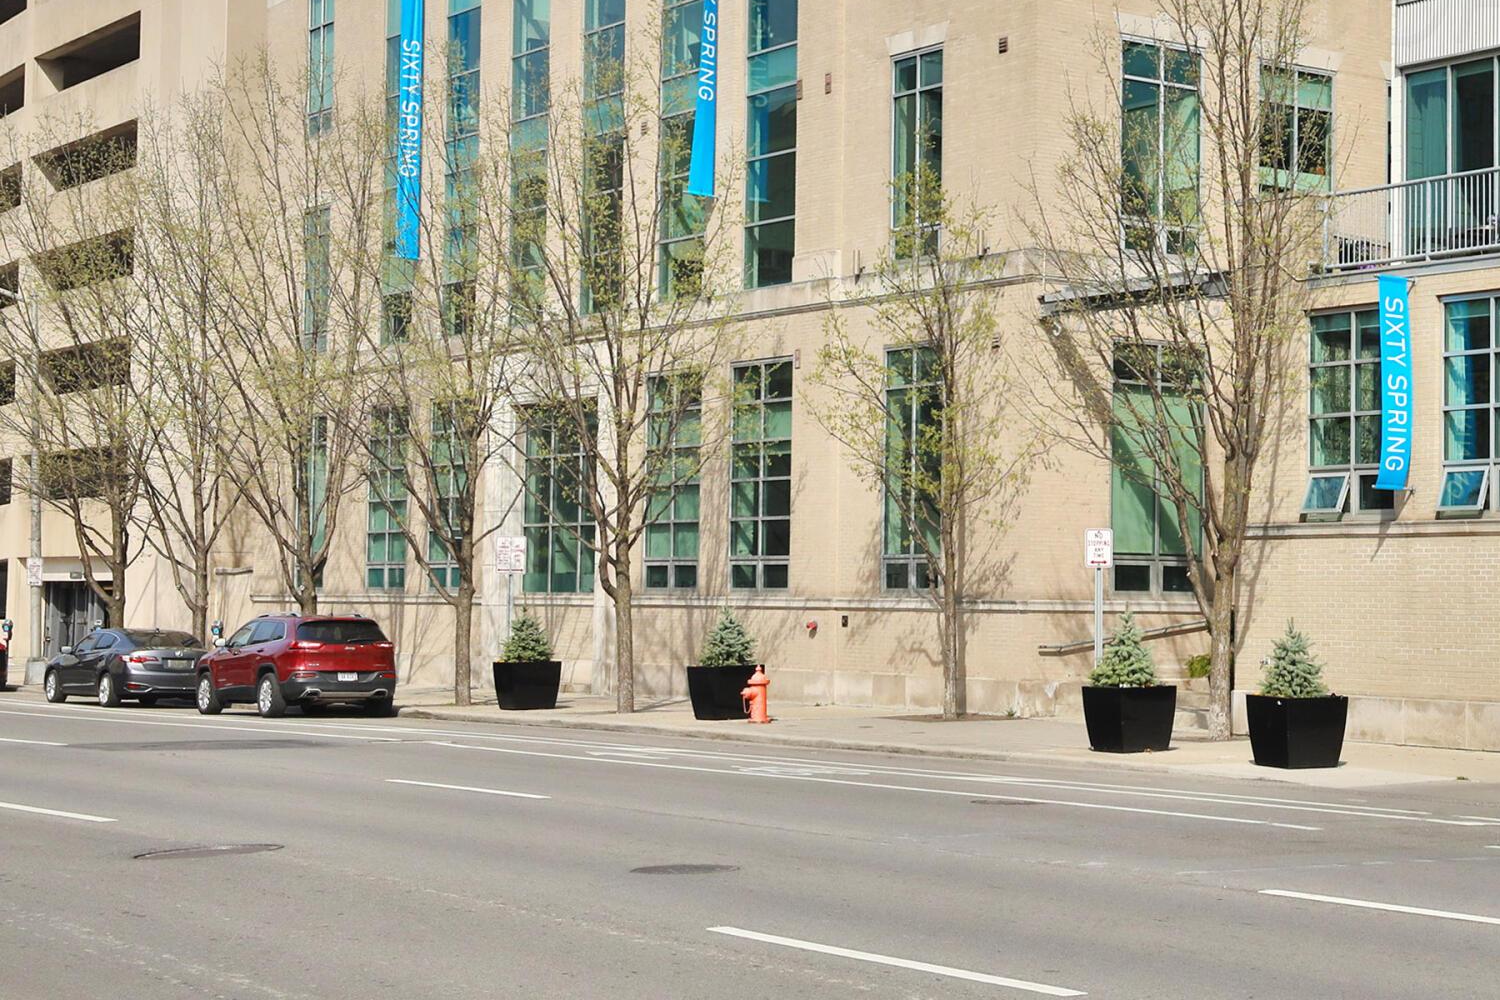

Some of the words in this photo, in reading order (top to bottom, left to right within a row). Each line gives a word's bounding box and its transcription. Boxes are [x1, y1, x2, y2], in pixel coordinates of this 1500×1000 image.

[402, 39, 420, 96] SIXTY
[698, 10, 716, 101] SPRING
[400, 101, 419, 178] SPRING
[1385, 295, 1406, 367] SIXTY
[1385, 374, 1408, 471] SPRING
